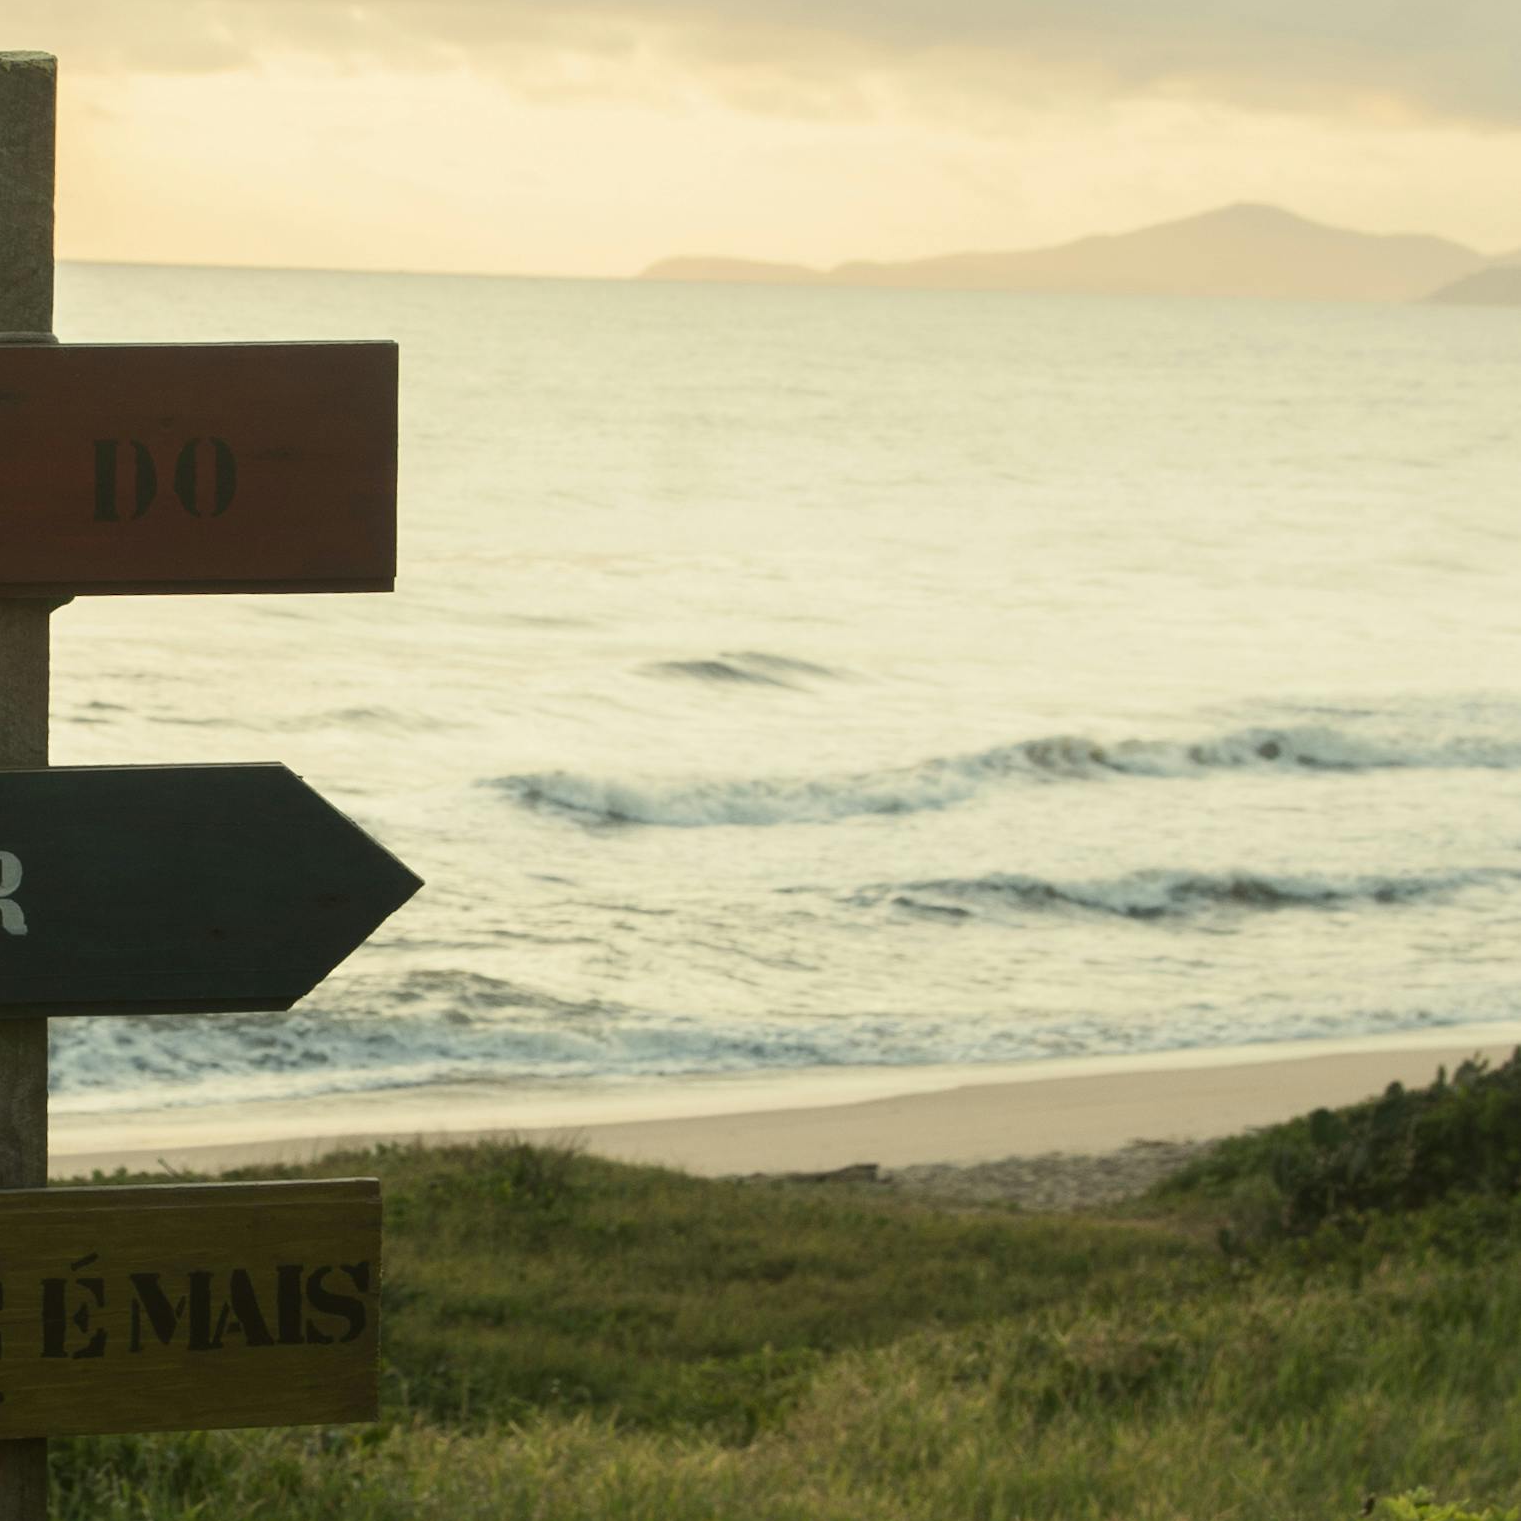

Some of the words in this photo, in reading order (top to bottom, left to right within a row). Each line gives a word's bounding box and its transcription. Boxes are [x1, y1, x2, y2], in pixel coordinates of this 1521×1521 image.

[92, 435, 239, 523] DO
[39, 1250, 107, 1360] É
[129, 1259, 371, 1353] MAIS
